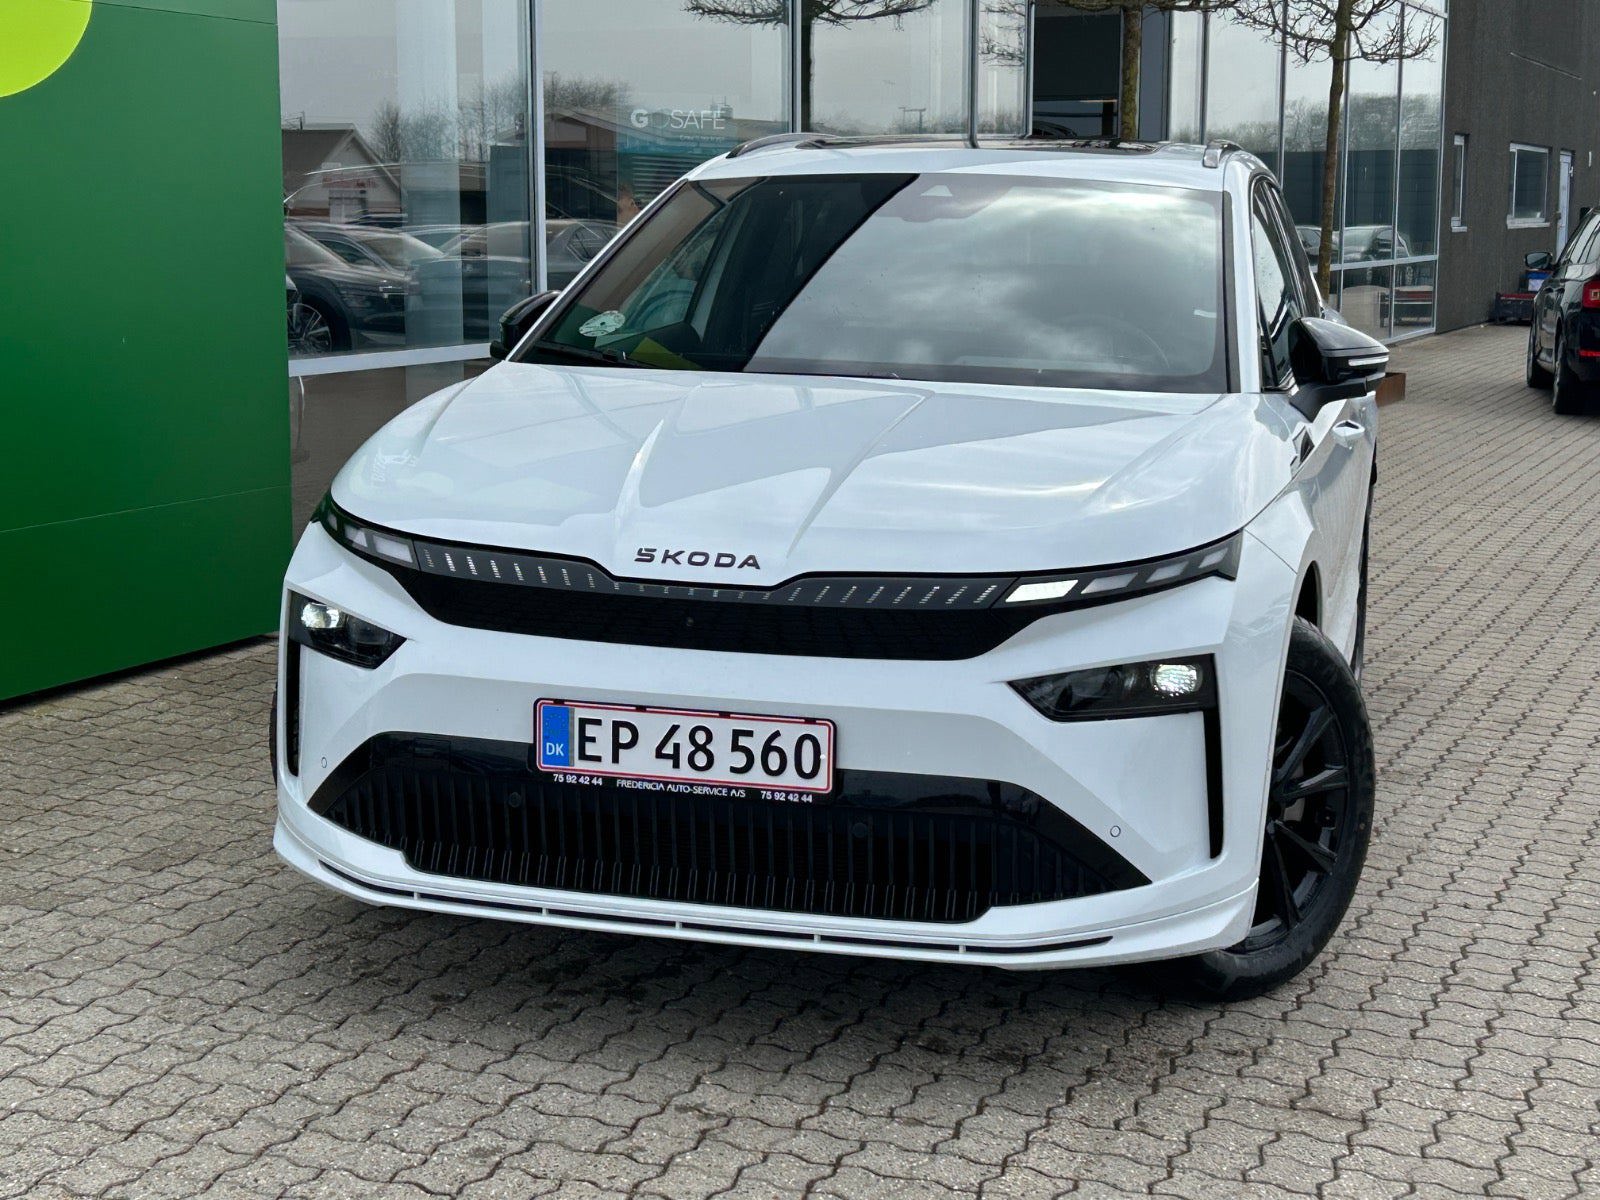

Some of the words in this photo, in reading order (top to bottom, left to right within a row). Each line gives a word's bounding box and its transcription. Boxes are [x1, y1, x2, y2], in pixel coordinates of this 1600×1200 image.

[546, 742, 564, 757] DK
[578, 717, 639, 764] EP
[655, 724, 715, 772] 48
[729, 728, 822, 780] 560
[616, 779, 665, 791] FREDERICIA
[667, 784, 728, 796] AUTO-SERVICE
[730, 789, 746, 798] A/S
